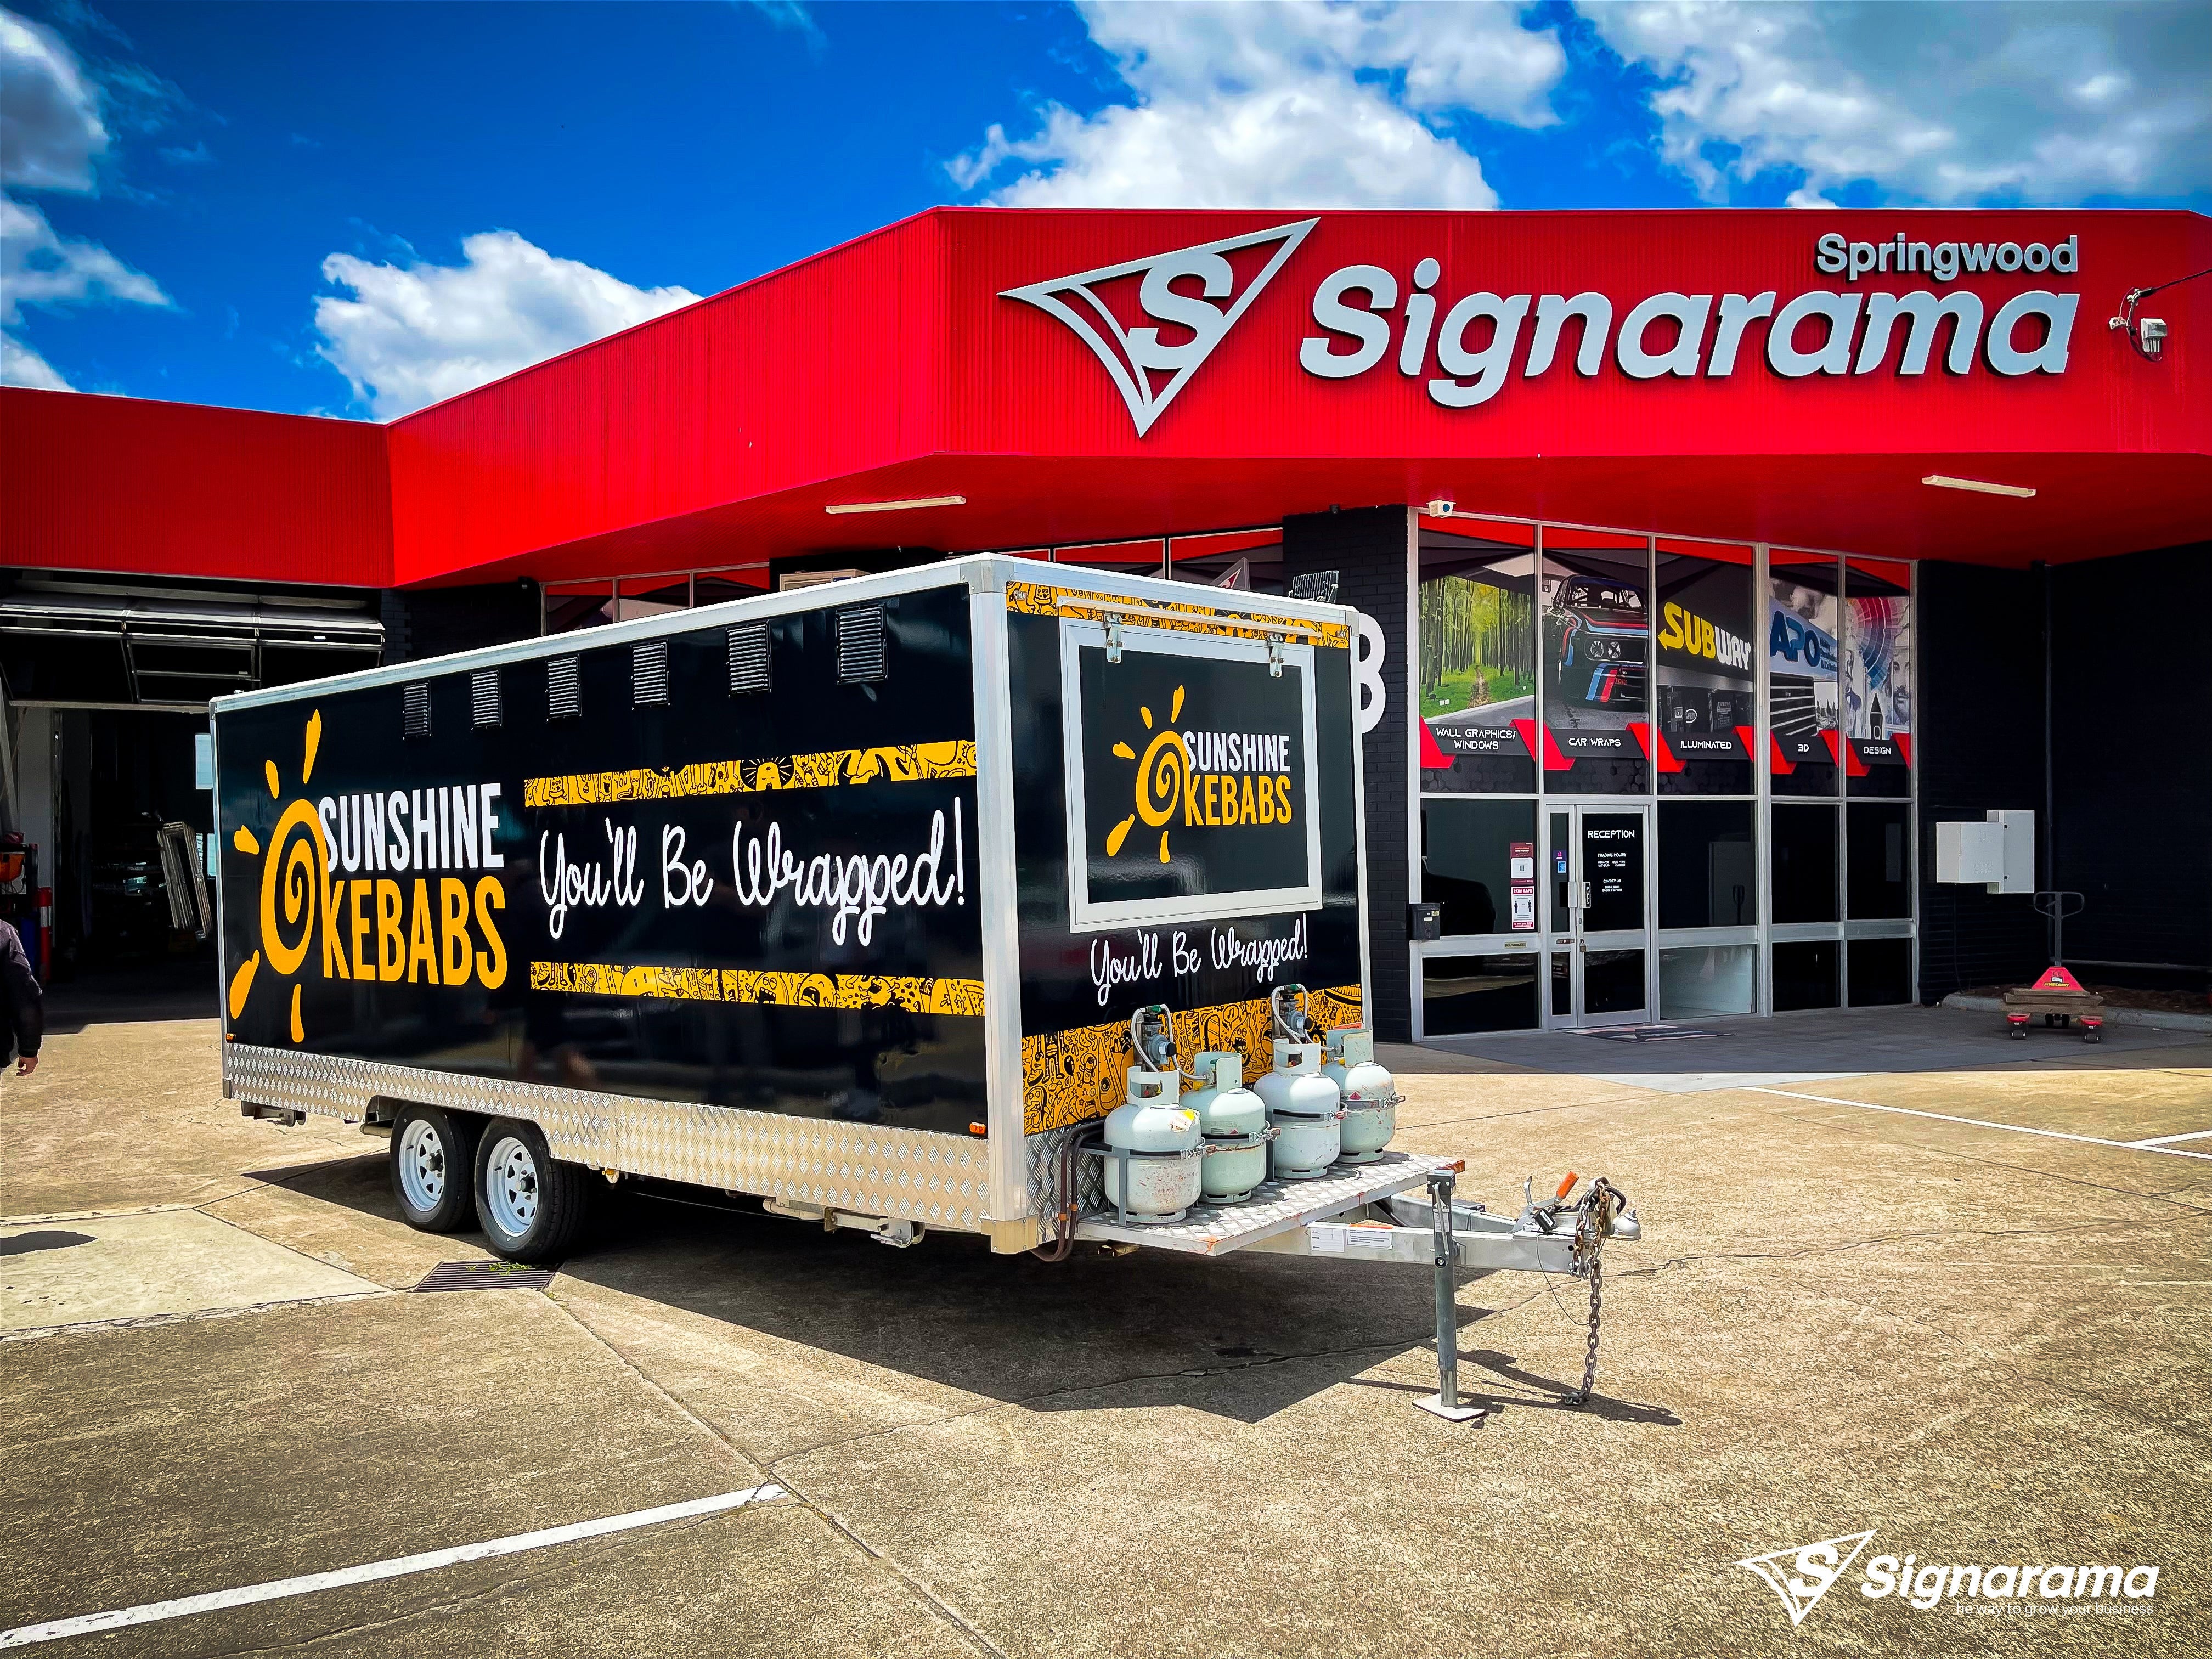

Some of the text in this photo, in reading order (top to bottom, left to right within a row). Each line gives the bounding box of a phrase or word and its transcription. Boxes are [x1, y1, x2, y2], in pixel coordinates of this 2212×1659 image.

[1817, 232, 2079, 281] Springwood
[1299, 258, 2081, 408] Signarama
[1657, 601, 1752, 670] SUBWAY
[1769, 609, 1820, 667] APO
[1182, 731, 1291, 772] SUNSHINE
[1436, 727, 1516, 740] WALL GRAPHICS/
[1454, 740, 1499, 750] WINDOWS
[1568, 737, 1622, 747] CAR WRAPS
[1680, 740, 1733, 750] ILLUMINATED
[1797, 743, 1810, 753] 3D
[1864, 746, 1892, 755] DESIGN
[614, 776, 628, 789] YOU
[1185, 775, 1293, 827] KEBABS
[318, 782, 504, 873] SUNSHINE
[1588, 830, 1635, 839] RECEPTION
[540, 796, 965, 947] You'll Be Wrapped!
[323, 876, 507, 989] KEBABS
[1091, 913, 1308, 1006] You'll Be Wrapped!
